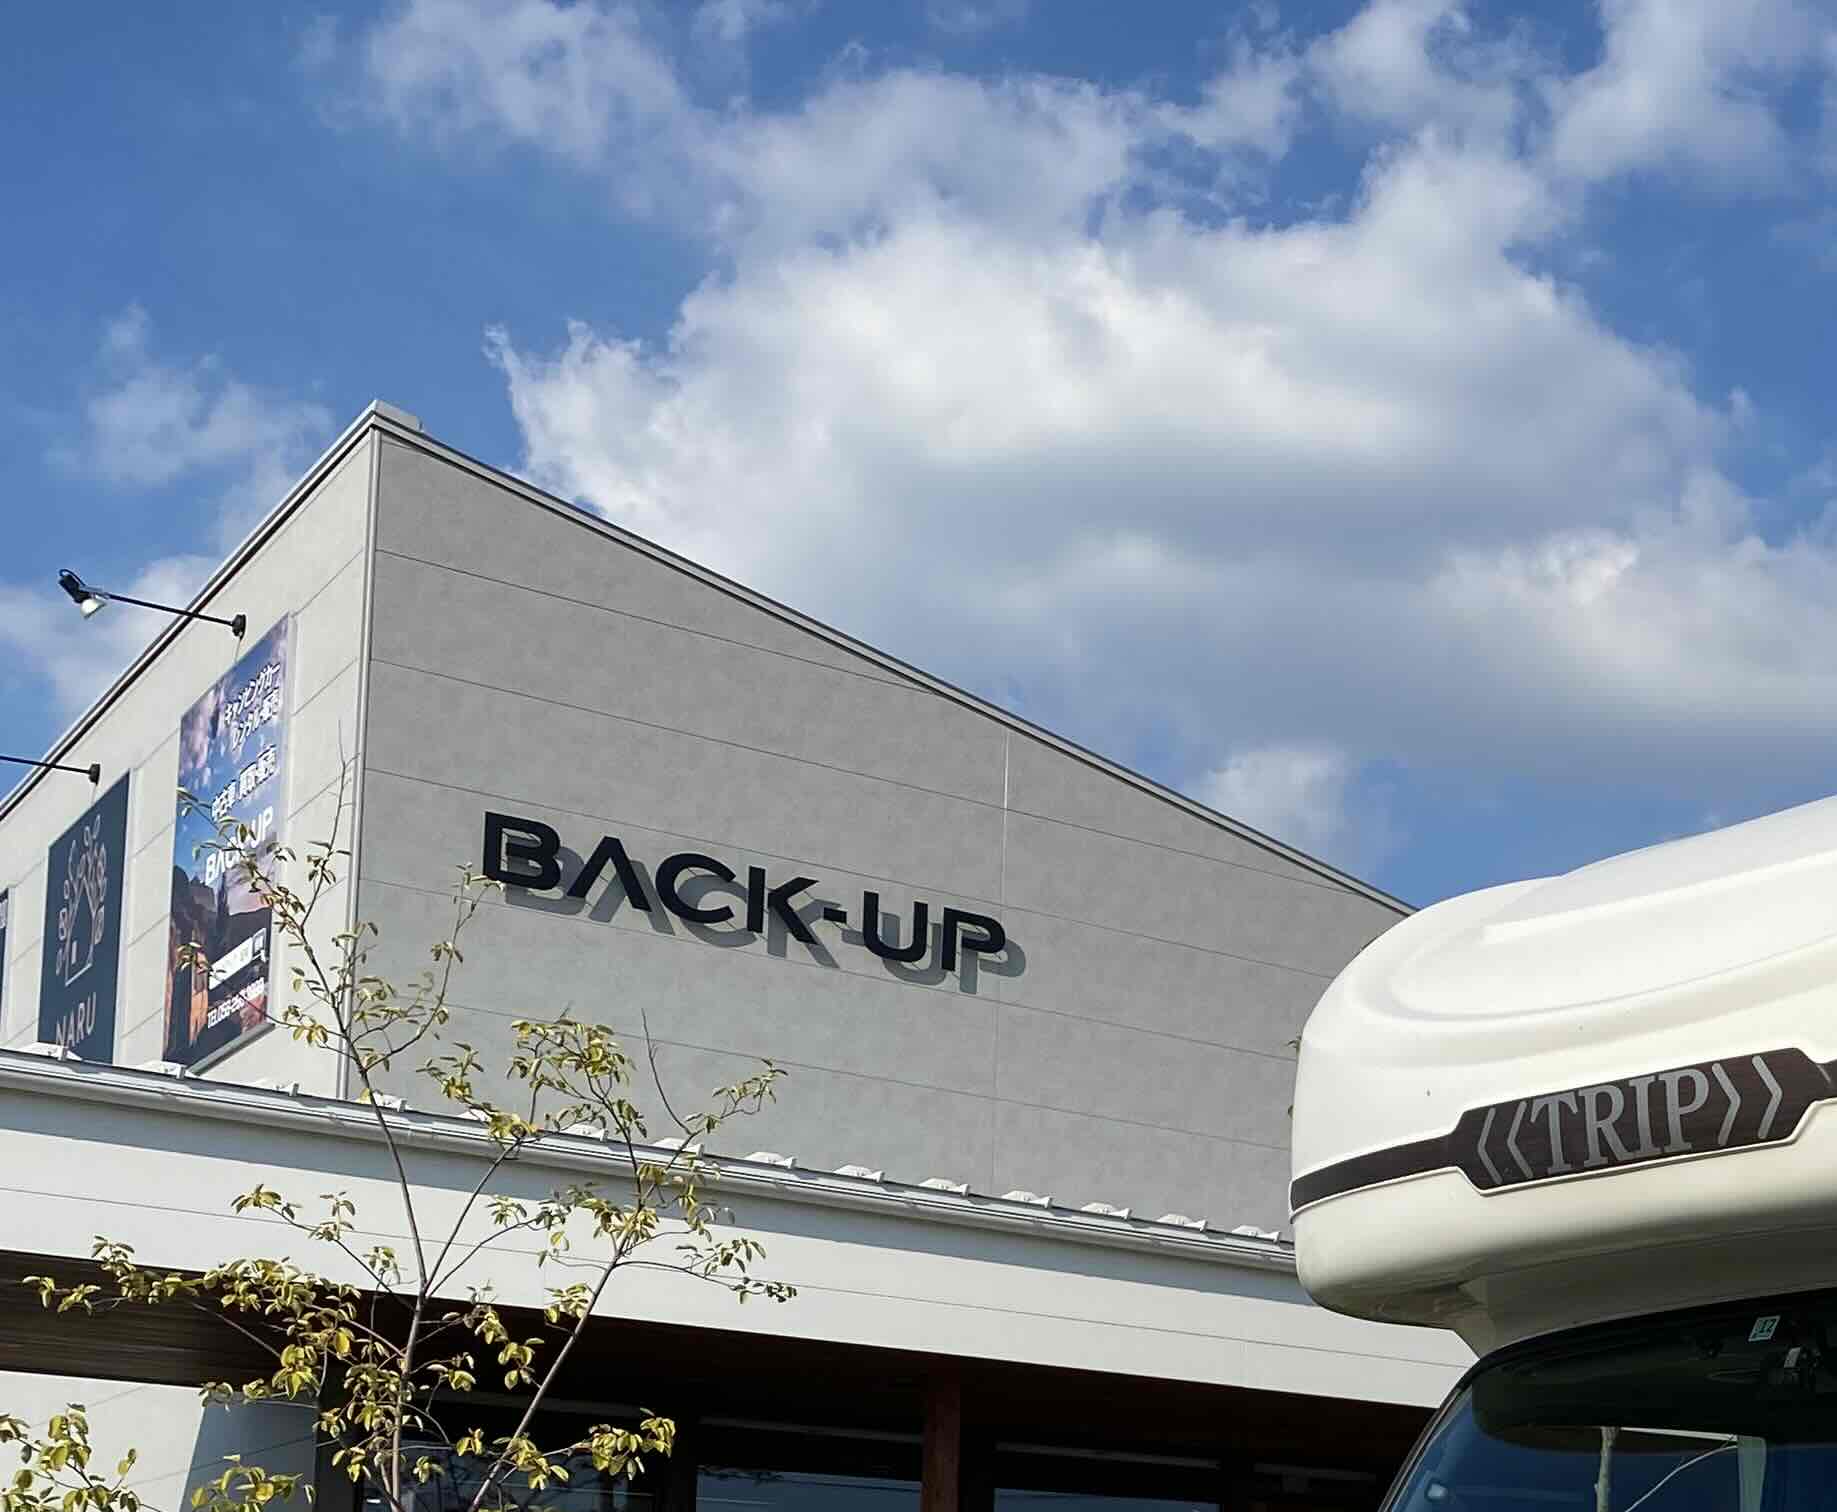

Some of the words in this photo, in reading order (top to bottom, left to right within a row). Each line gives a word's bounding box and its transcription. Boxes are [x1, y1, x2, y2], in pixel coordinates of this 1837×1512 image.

[482, 811, 1007, 972] BACK-UP
[55, 992, 97, 1048] NARU
[1529, 1068, 1711, 1174] TRIP
